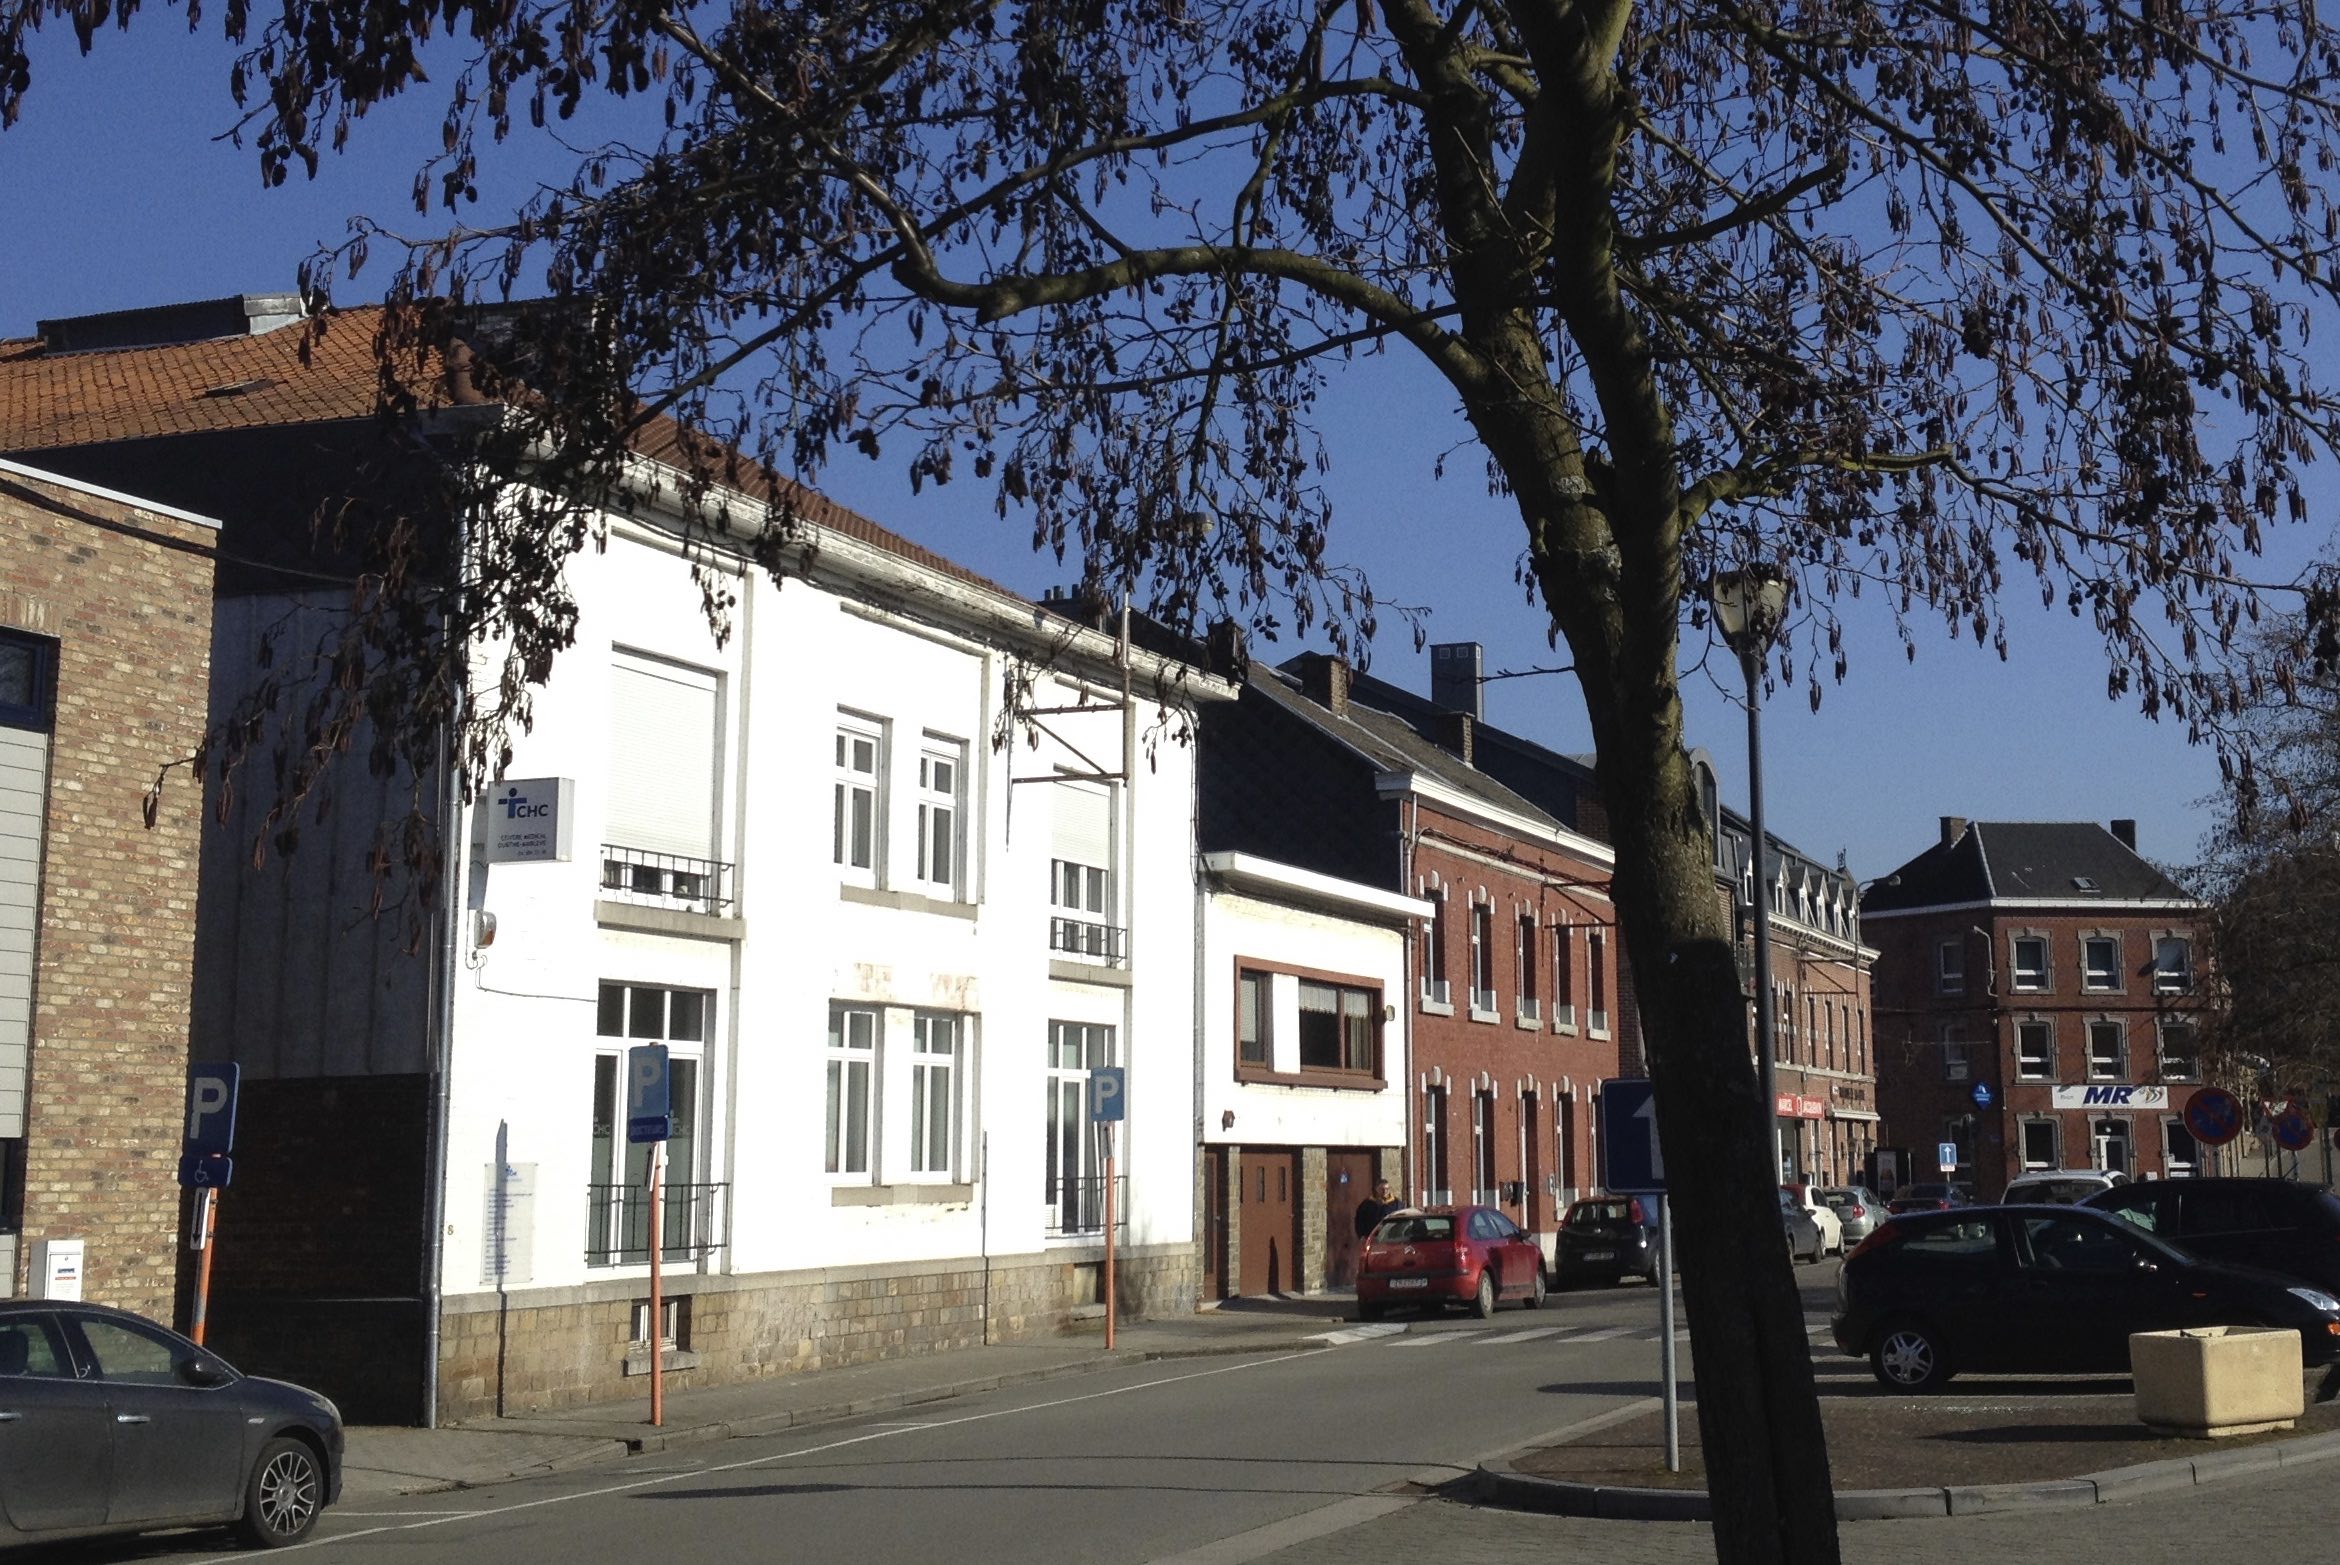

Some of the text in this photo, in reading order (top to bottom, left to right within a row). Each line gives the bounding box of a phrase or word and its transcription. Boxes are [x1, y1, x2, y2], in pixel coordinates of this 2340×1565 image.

[516, 804, 549, 818] CHC
[633, 1057, 662, 1107] P
[1095, 1075, 1119, 1114] P
[2082, 1086, 2134, 1104] MR
[190, 1077, 228, 1139] P
